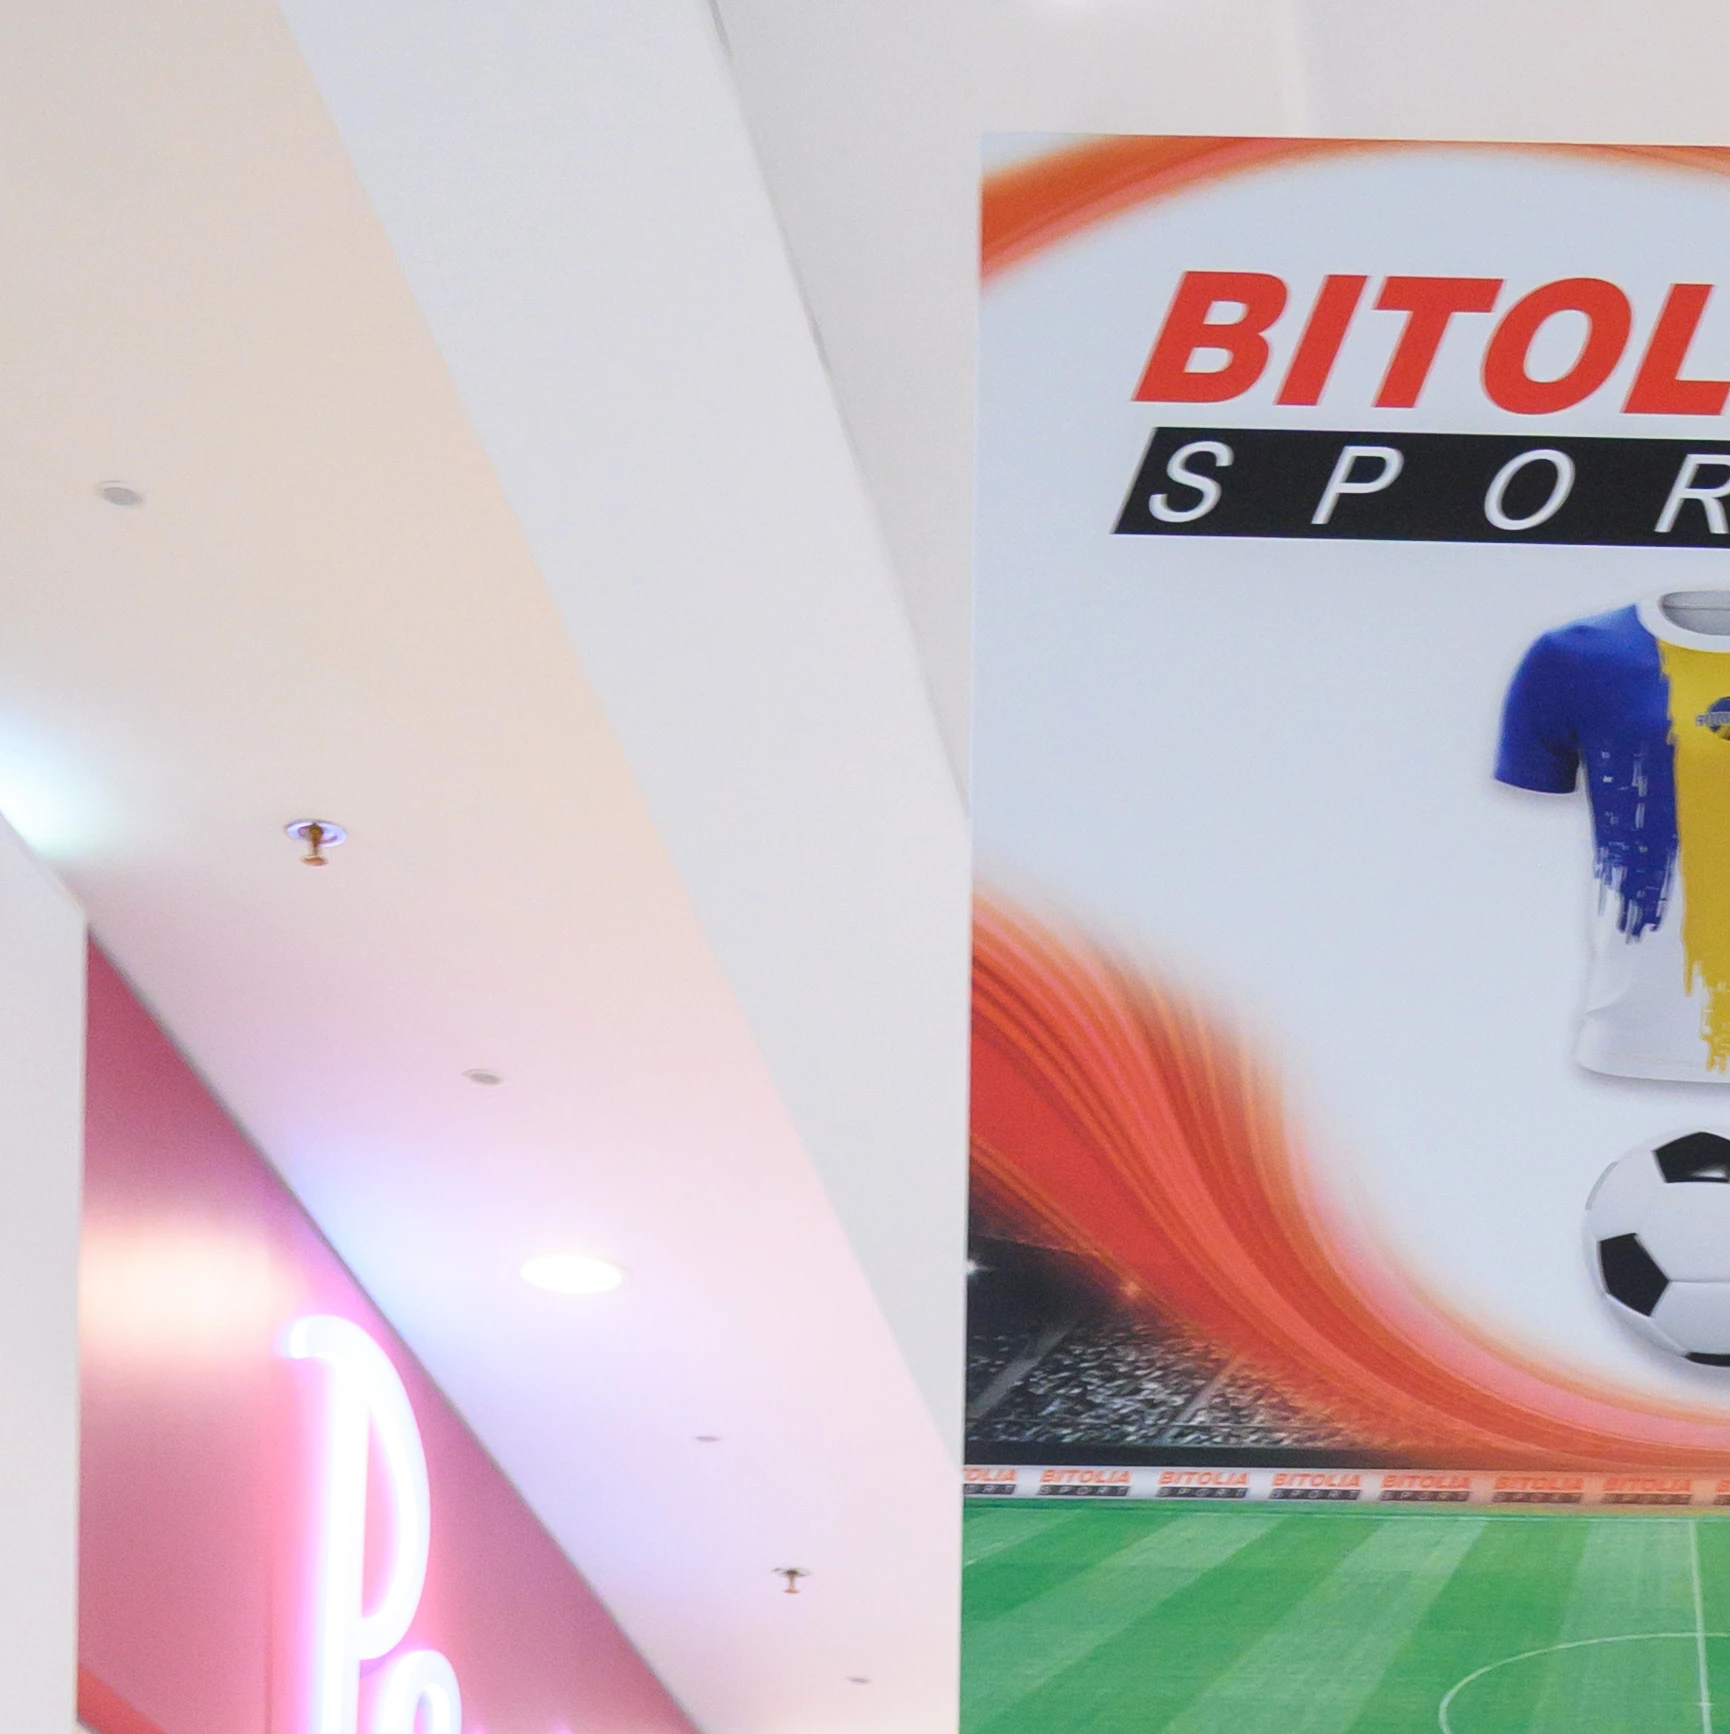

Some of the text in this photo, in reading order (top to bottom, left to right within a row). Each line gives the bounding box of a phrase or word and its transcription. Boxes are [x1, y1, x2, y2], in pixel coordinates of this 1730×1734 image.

[1041, 1469, 1131, 1484] BITOLIA
[1160, 1471, 1248, 1485] BITOLIA
[1272, 1473, 1362, 1487] BITOLIA
[1038, 1485, 1129, 1496] SPORT
